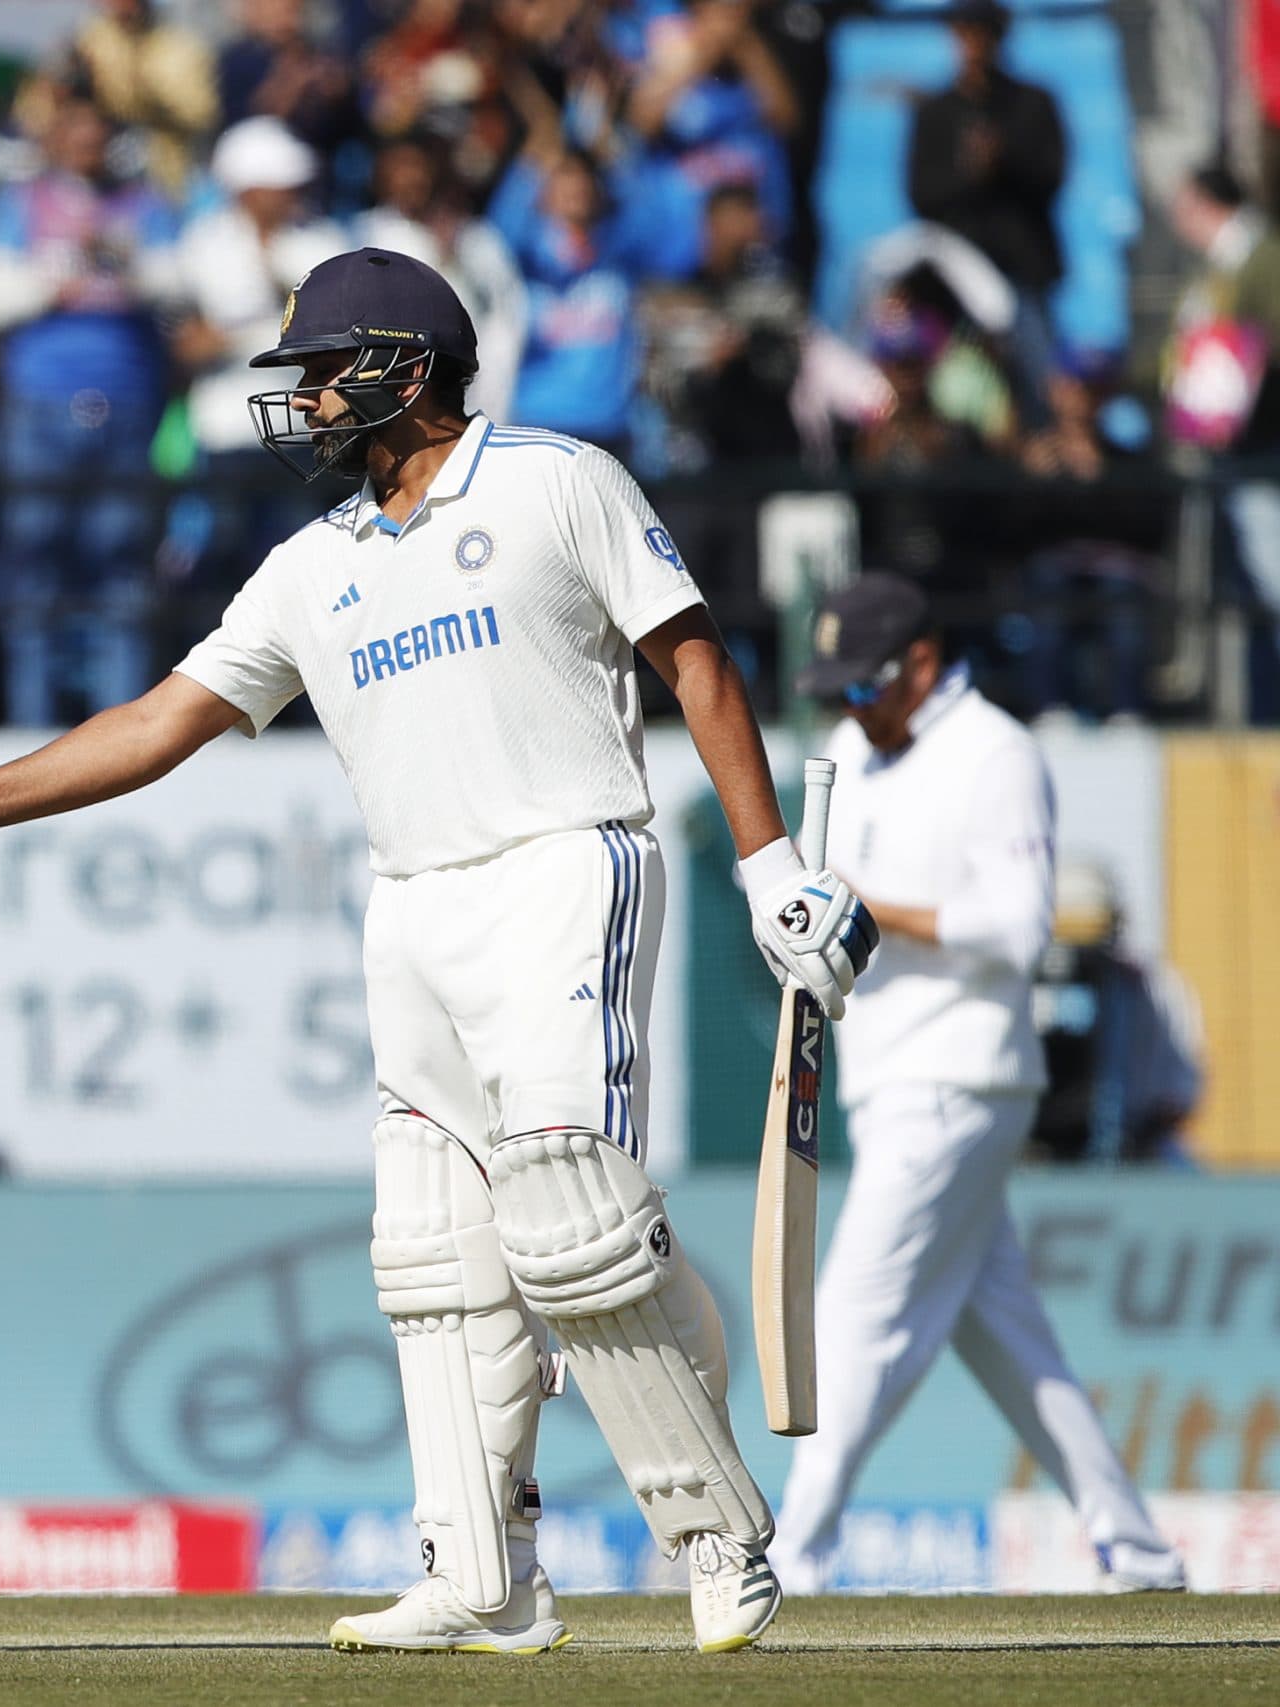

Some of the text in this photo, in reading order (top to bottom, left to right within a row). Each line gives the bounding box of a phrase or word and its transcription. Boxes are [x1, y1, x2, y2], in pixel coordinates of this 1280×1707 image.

[368, 328, 414, 339] MASURI
[350, 605, 500, 690] DREAM11
[797, 1005, 820, 1142] CEAT
